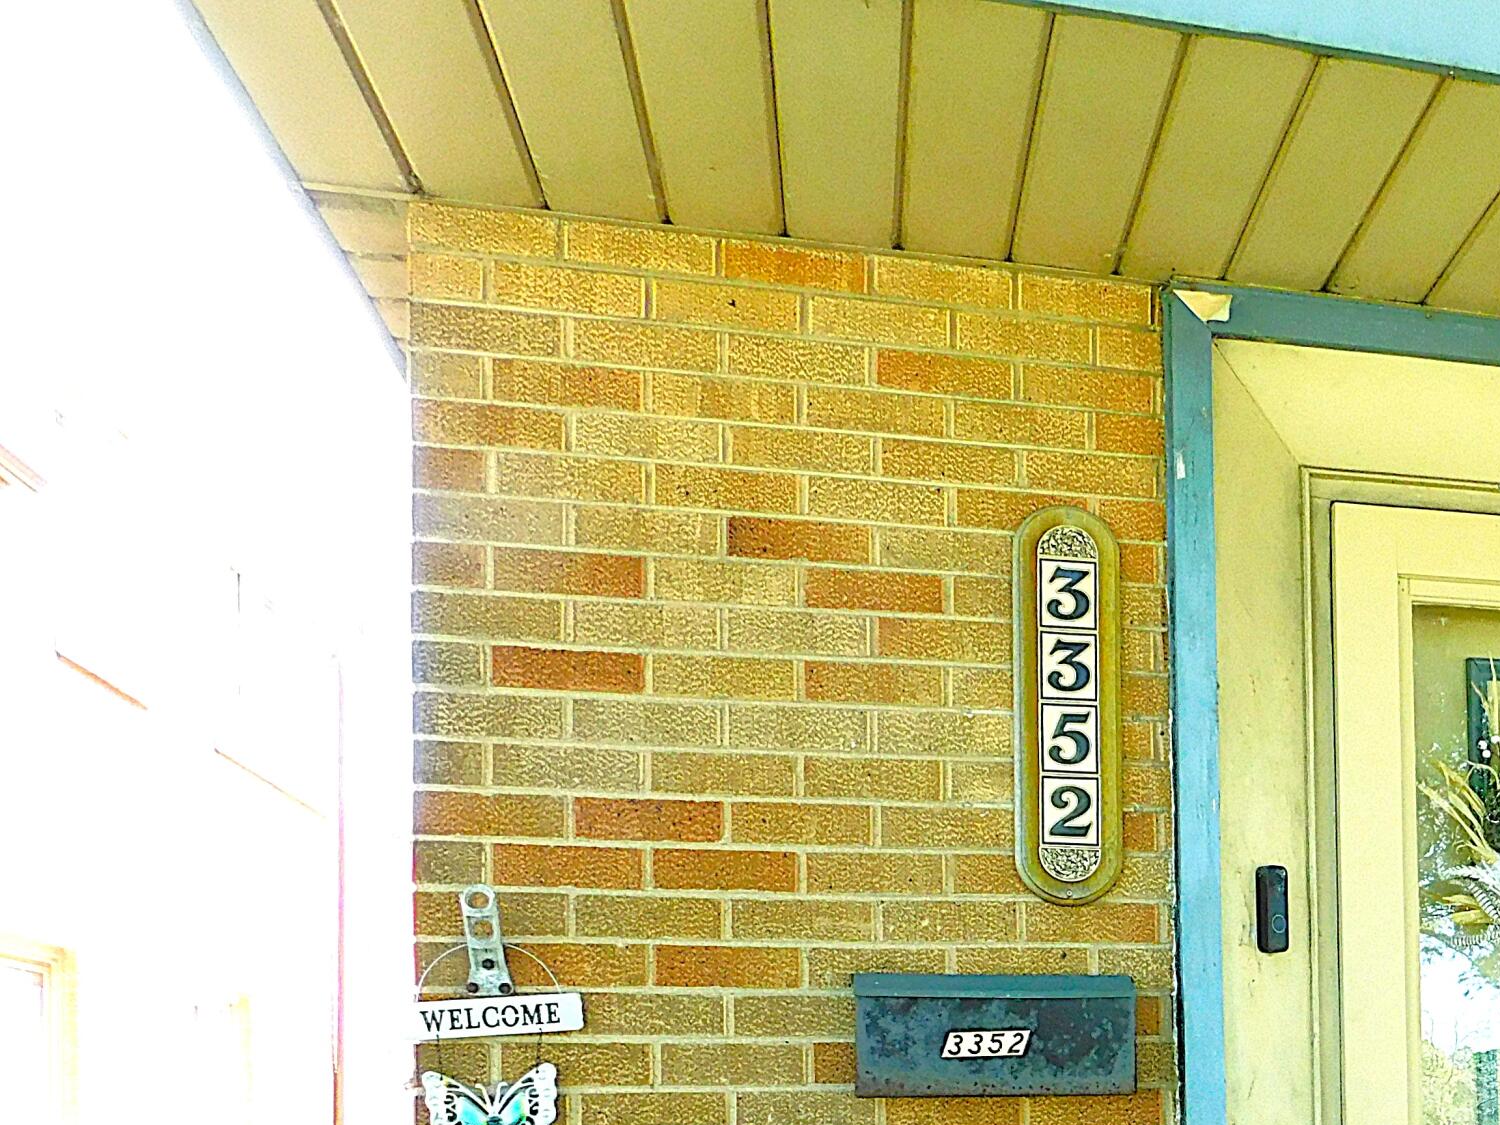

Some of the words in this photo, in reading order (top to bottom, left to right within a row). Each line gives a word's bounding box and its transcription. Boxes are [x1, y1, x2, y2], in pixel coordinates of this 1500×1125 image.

[1046, 566, 1092, 837] 3352
[419, 1002, 561, 1032] WELCOME
[947, 1032, 1024, 1056] 3352
